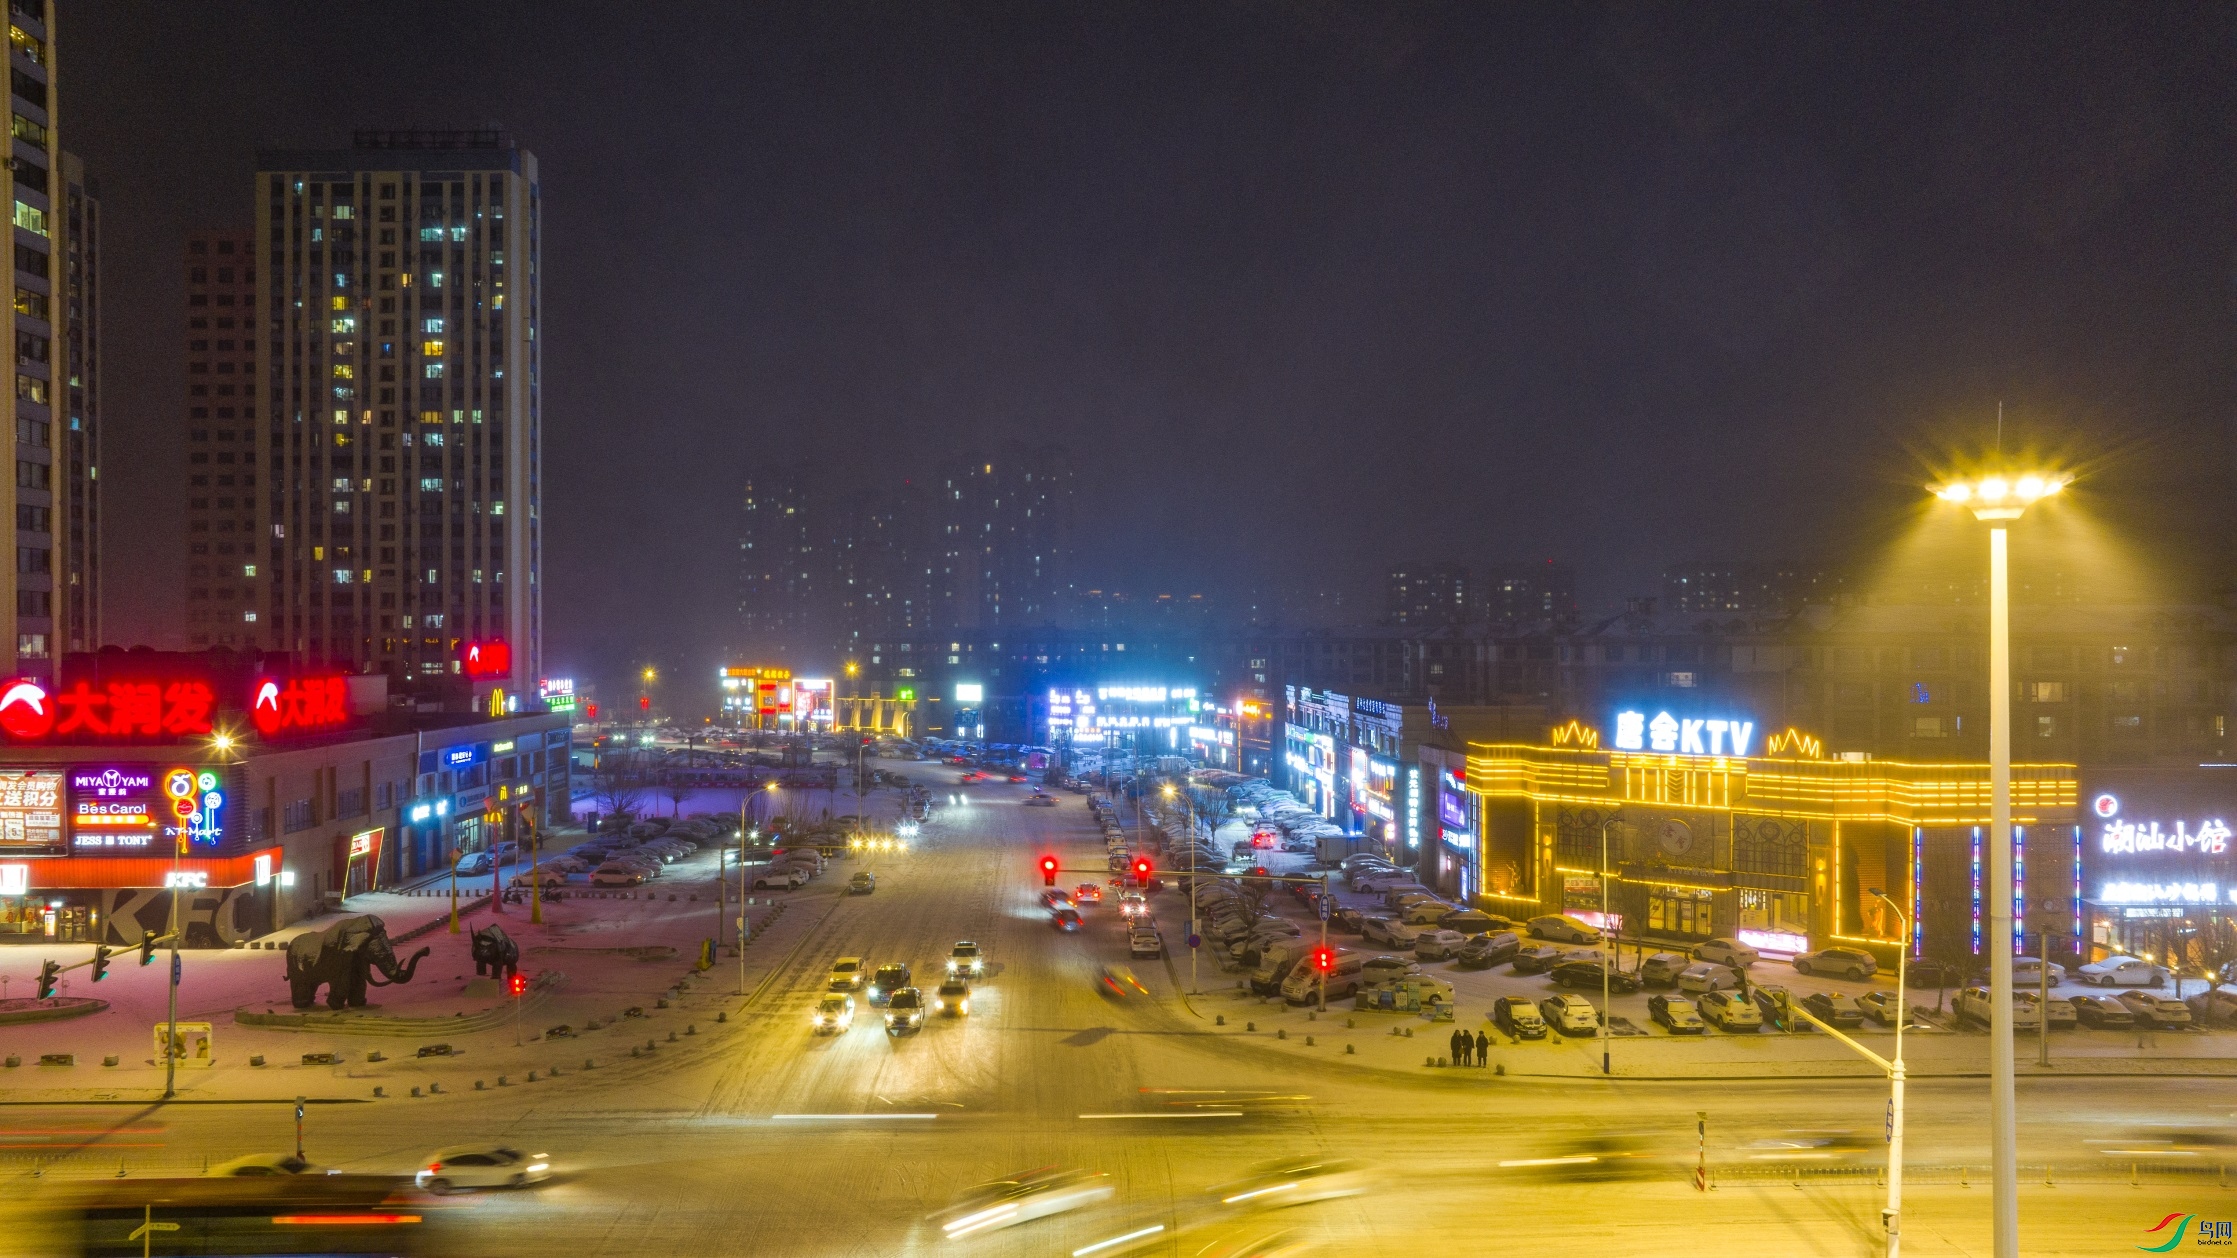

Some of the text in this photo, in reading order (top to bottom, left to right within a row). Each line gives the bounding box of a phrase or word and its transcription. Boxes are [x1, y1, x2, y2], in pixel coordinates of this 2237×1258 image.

[57, 682, 214, 734] 大润发
[282, 677, 346, 728] 大润发
[0, 790, 57, 806] 送积分
[109, 804, 147, 814] Carol
[75, 835, 102, 846] JESS
[2103, 819, 2232, 854] 潮汕小馆
[165, 872, 208, 888] KFC
[101, 888, 255, 948] KFC
